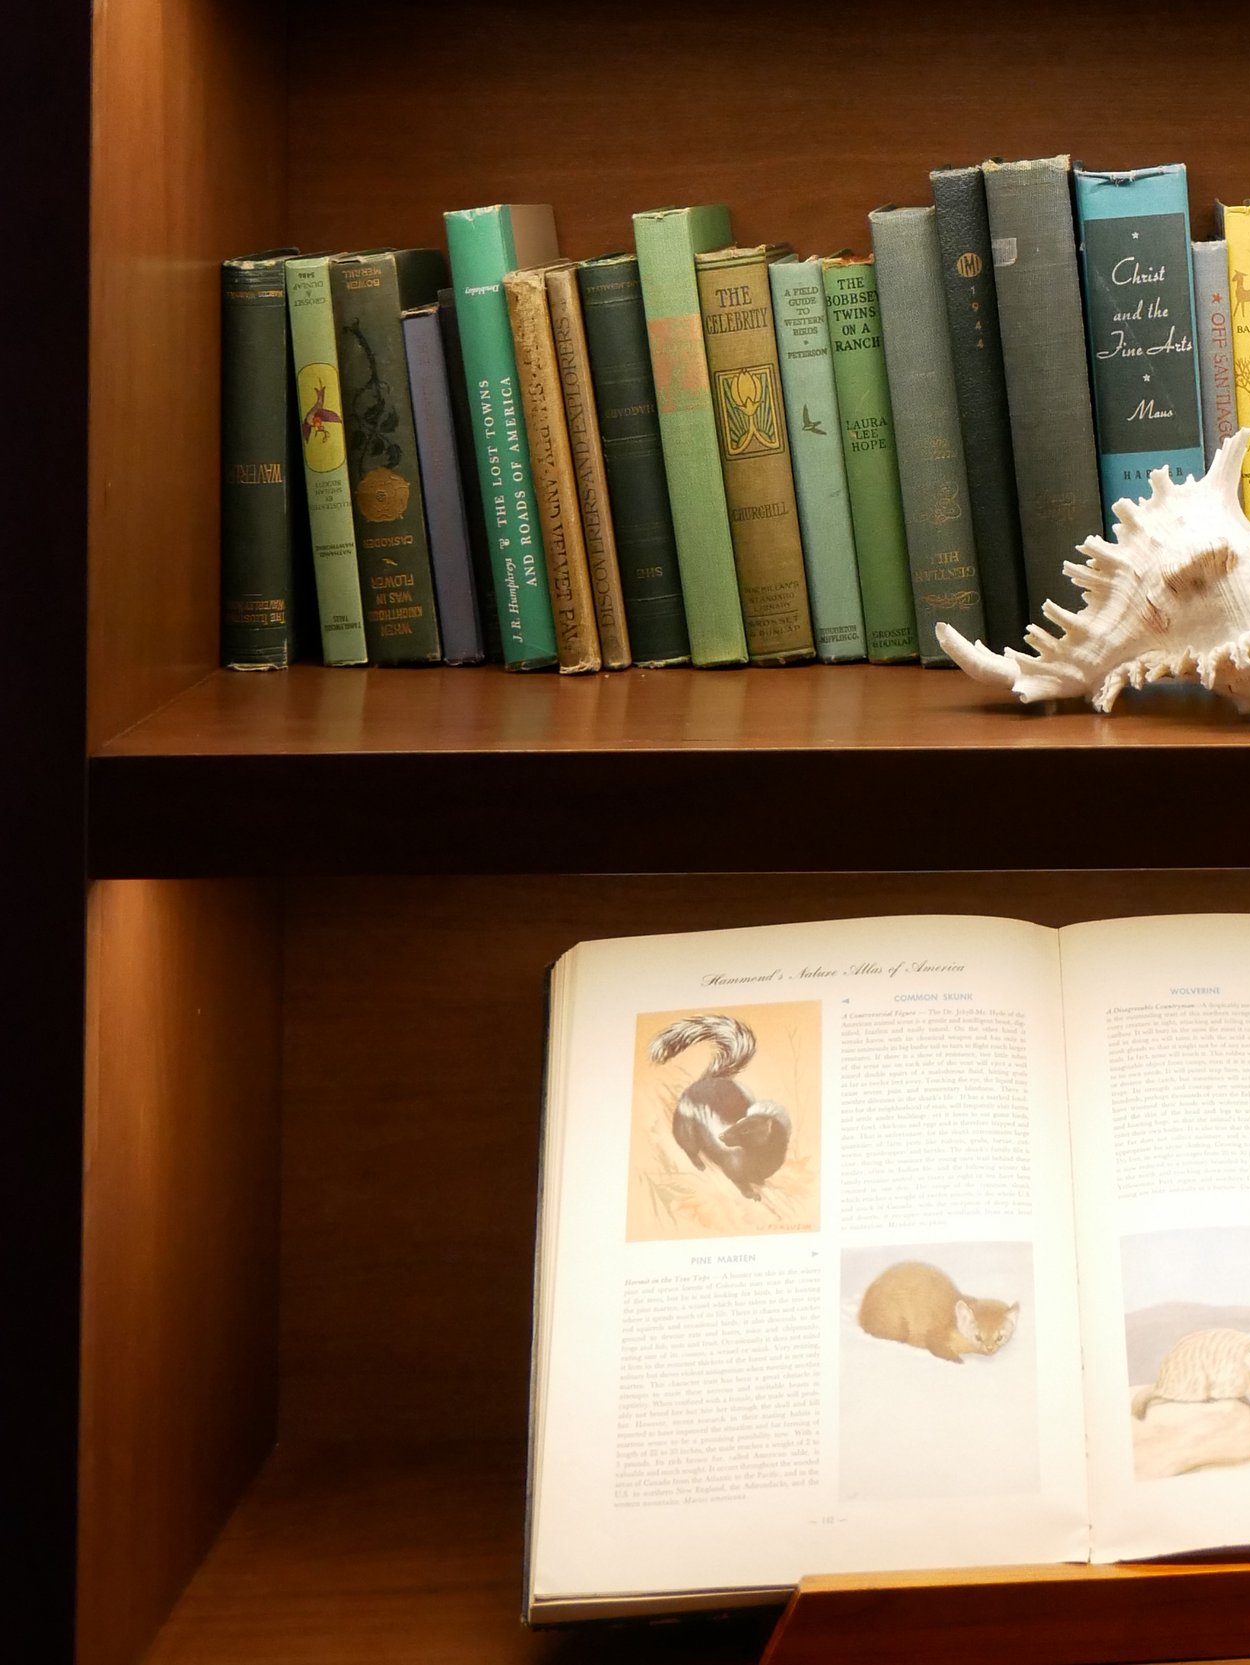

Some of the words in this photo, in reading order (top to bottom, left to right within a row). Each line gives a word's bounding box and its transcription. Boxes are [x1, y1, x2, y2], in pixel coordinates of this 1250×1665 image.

[1112, 257, 1165, 285] Christ
[838, 277, 865, 290] THE
[715, 286, 752, 307] THE
[789, 297, 816, 306] GUIDE
[705, 308, 768, 334] CELEBRITY
[833, 306, 875, 322] TWINS
[1113, 301, 1141, 321] and
[1148, 297, 1168, 319] the
[842, 324, 858, 336] ON
[861, 322, 870, 333] A
[788, 347, 827, 359] PETERSON
[835, 336, 880, 351] RANCH
[1097, 330, 1143, 359] Fine
[1146, 326, 1192, 356] Arts
[556, 319, 586, 437] EXPLORERS
[480, 379, 496, 446] TOWNS
[500, 376, 521, 460] AMERICA
[847, 417, 887, 431] LAURA
[851, 439, 886, 452] HOPE
[856, 429, 879, 440] LEE
[491, 446, 504, 487] LOST
[512, 462, 525, 486] OF
[575, 442, 594, 487] AND
[497, 493, 508, 529] THE
[518, 493, 532, 555] ROADS
[524, 554, 538, 587] AND
[583, 488, 616, 629] DISCOVERERS
[504, 556, 520, 612] Humphreys
[511, 615, 522, 627] R.
[512, 631, 522, 642] J.
[701, 970, 783, 987] Hammond's
[789, 967, 836, 980] Nature
[844, 962, 882, 976] Atlas
[888, 963, 901, 975] of
[906, 960, 965, 973] America
[894, 993, 938, 1002] COMMON
[943, 993, 972, 1001] SKUNK
[1170, 987, 1220, 995] WOLVERINE
[691, 1256, 712, 1265] PINE
[717, 1255, 756, 1264] MARTEN
